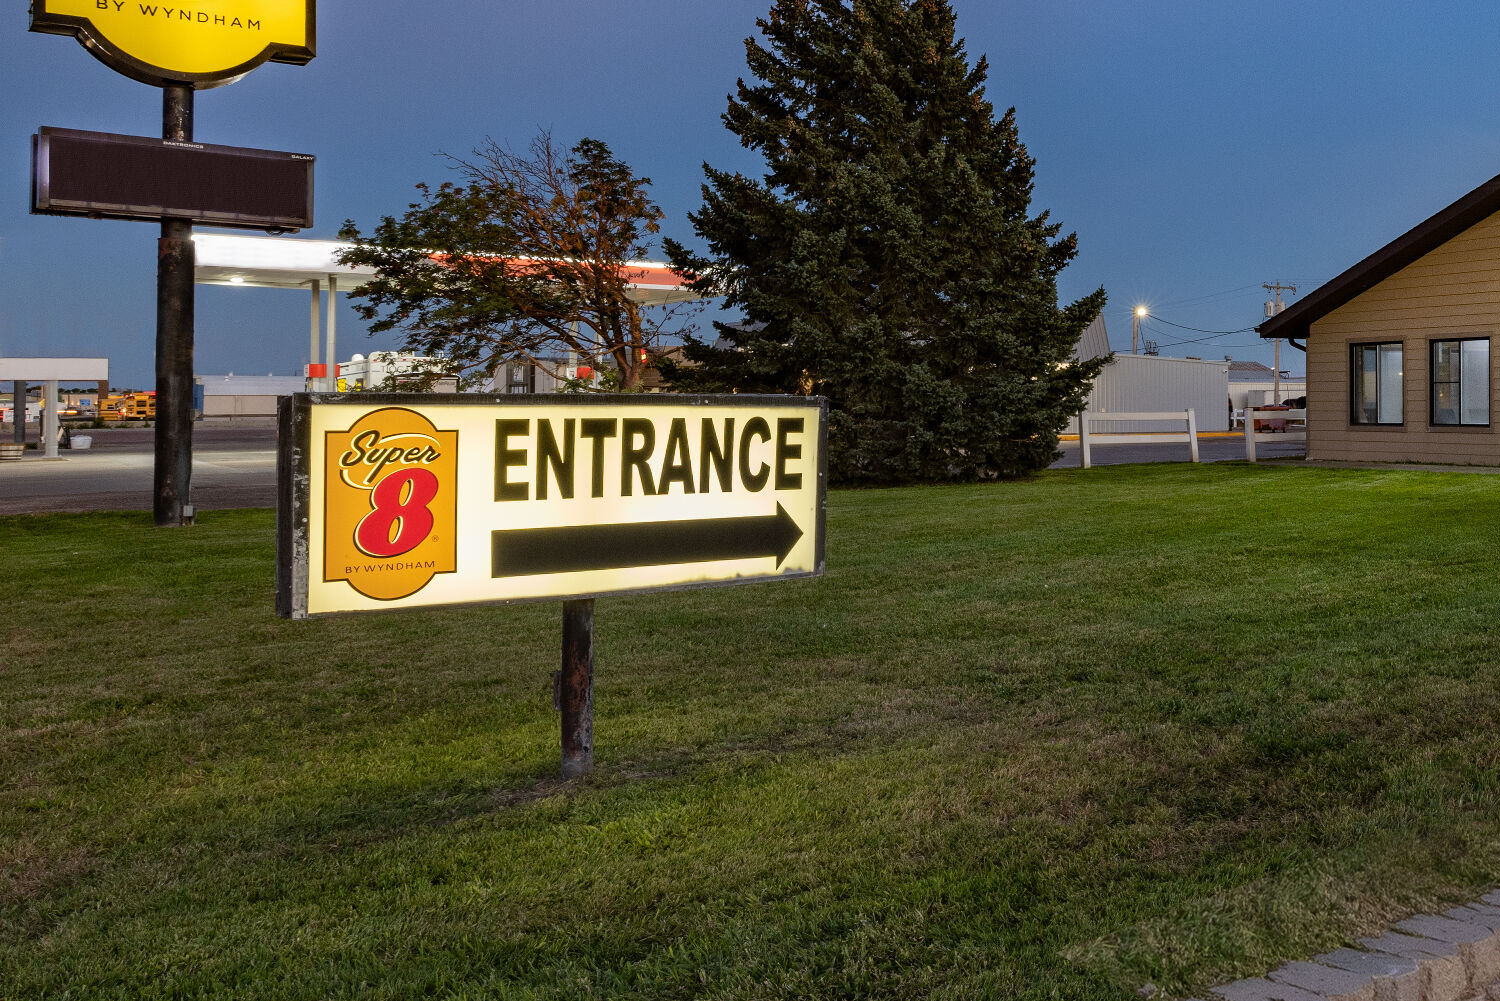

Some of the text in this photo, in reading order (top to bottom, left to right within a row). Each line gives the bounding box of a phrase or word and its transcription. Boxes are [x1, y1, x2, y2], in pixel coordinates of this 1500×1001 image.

[139, 3, 261, 31] WYNDHAM
[339, 429, 442, 486] Super
[493, 416, 805, 502] ENTRANCE
[353, 467, 439, 559] 8
[345, 560, 436, 574] BY WYNDHAM
